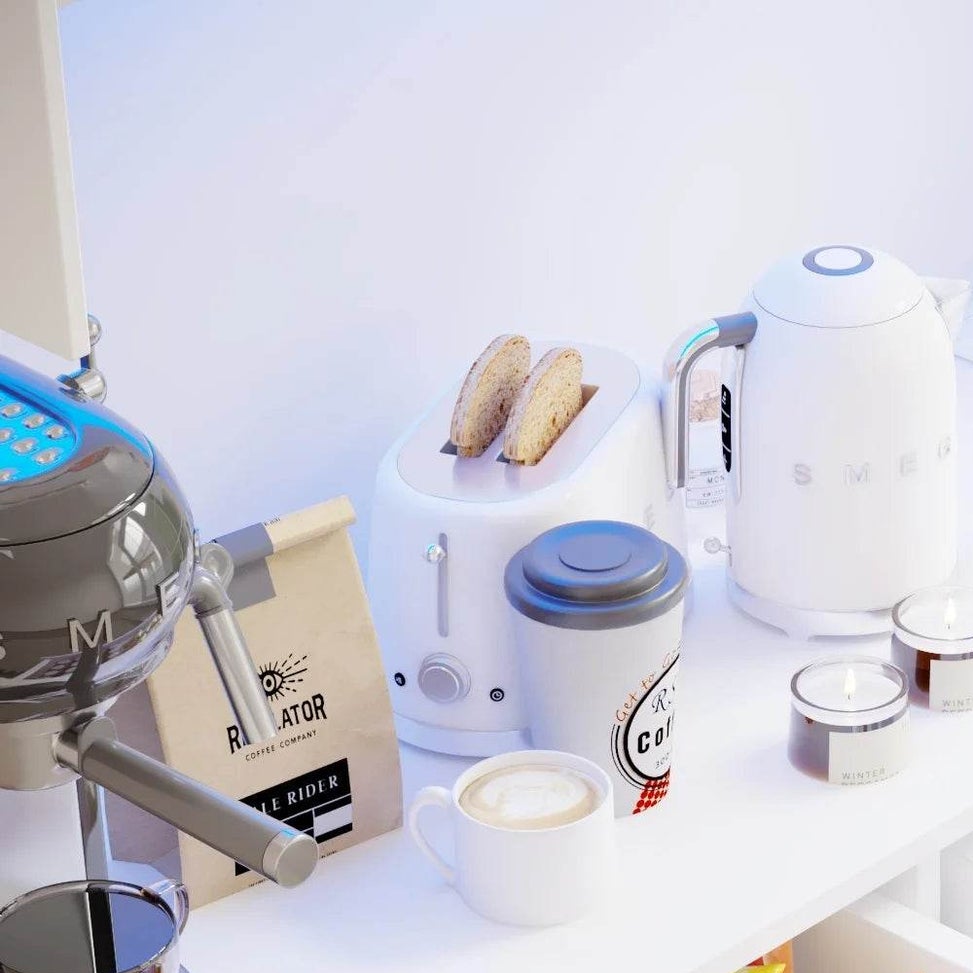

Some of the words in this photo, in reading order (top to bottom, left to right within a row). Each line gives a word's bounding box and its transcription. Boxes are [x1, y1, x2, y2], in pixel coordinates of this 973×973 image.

[245, 744, 276, 762] COFFEE
[279, 729, 318, 749] COMPANY
[842, 768, 886, 780] WINTER
[287, 775, 338, 805] RIDER
